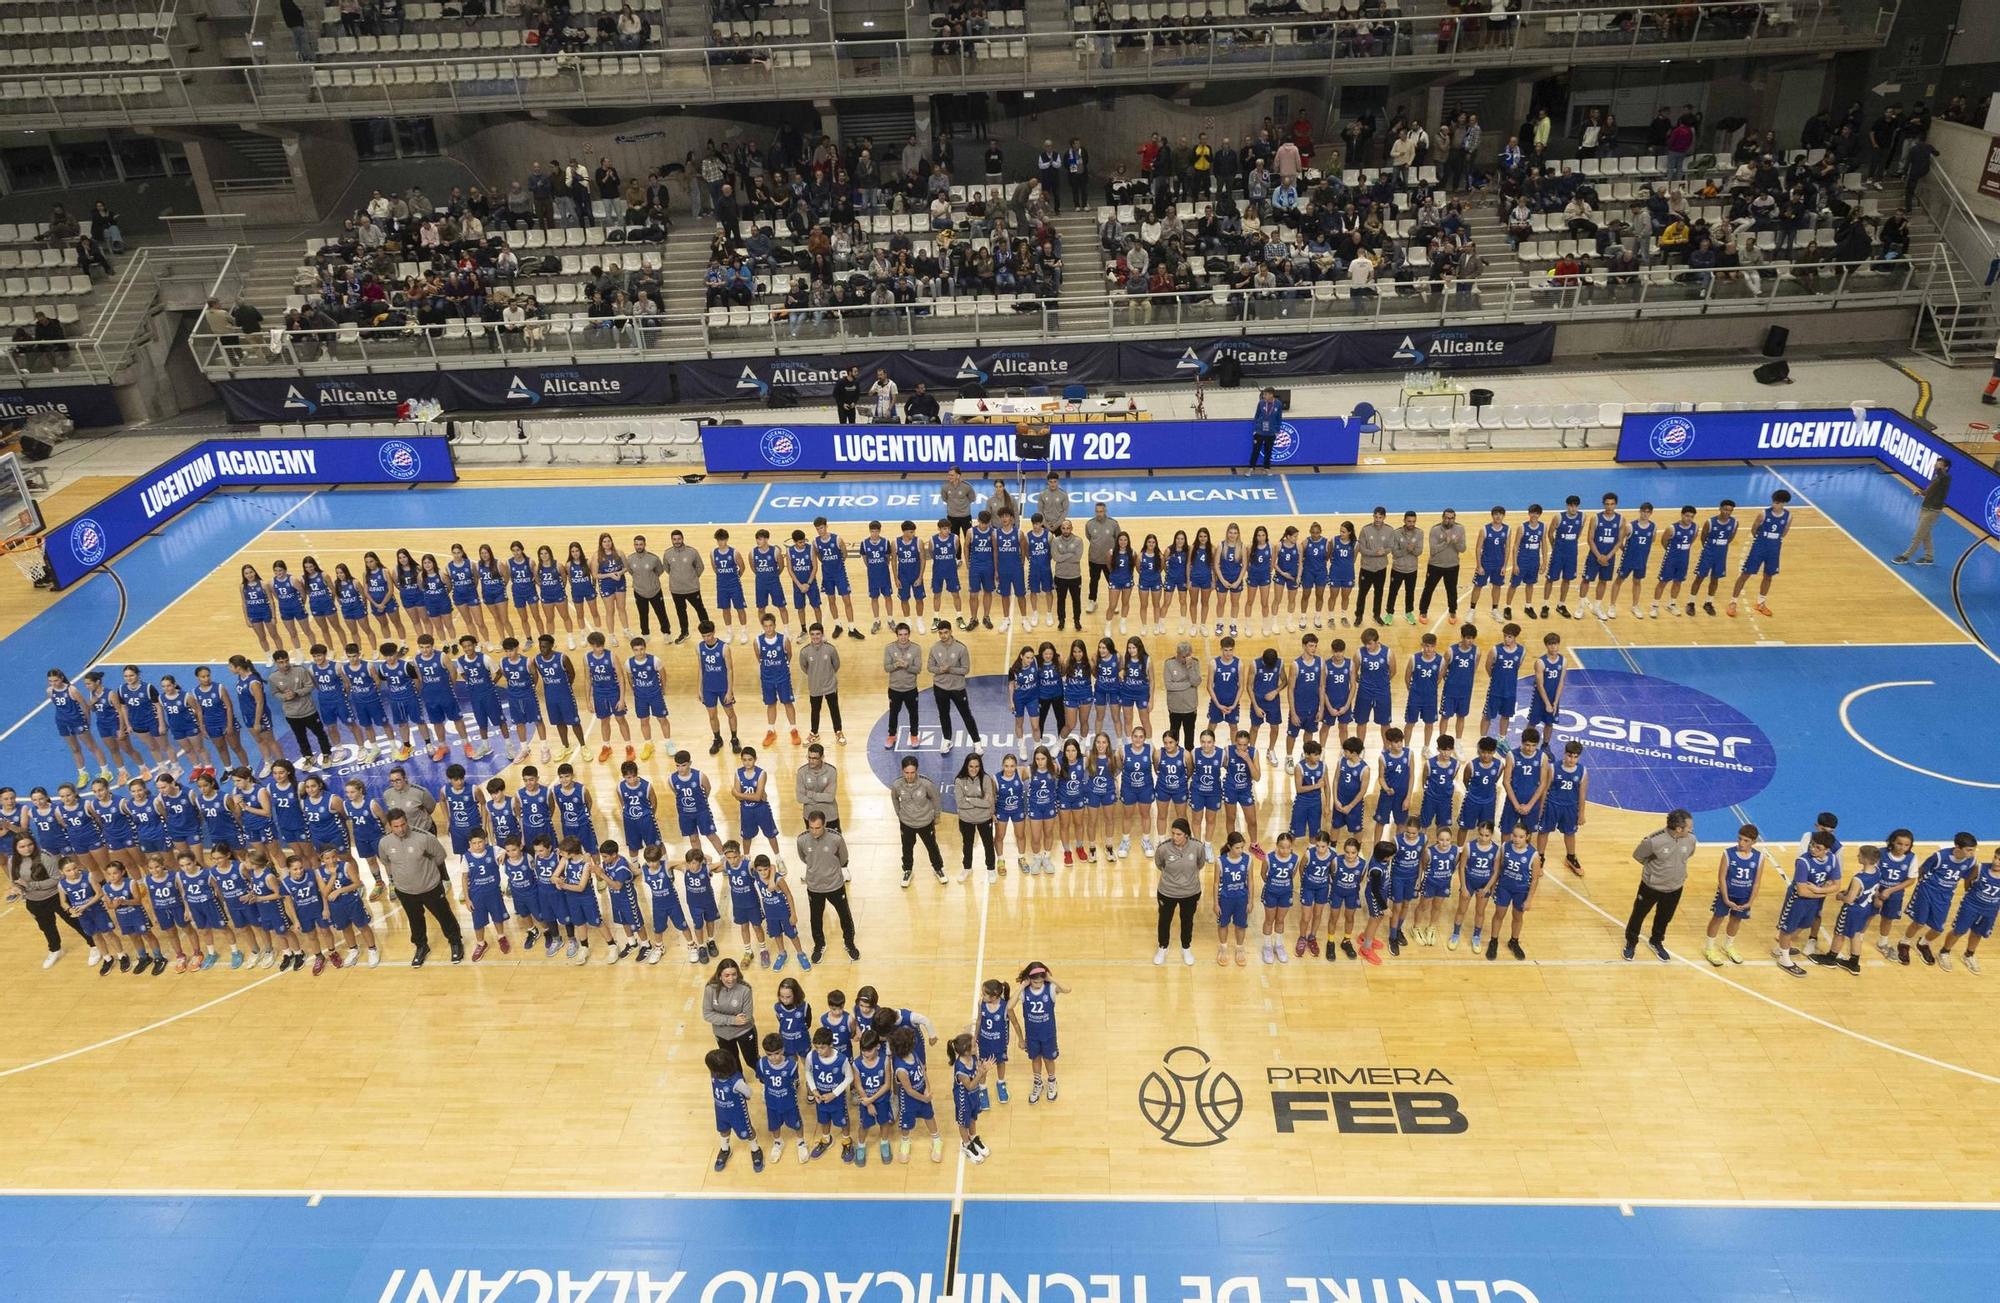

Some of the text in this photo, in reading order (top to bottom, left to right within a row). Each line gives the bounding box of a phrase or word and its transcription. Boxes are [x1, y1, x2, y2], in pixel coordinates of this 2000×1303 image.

[1430, 339, 1504, 353] Alicante
[993, 359, 1068, 373] Alicante
[544, 378, 620, 393] Alicante
[320, 389, 397, 403] Alicante
[765, 430, 794, 441] LUCENTUM
[833, 434, 955, 463] LUCENTUM
[1083, 432, 1131, 460] 202
[1757, 421, 1941, 481] LUCENTUM ACADEM
[140, 449, 317, 519] LUCENTUM ACADEMY
[770, 494, 879, 508] CENTRO
[887, 494, 921, 507] DE
[1147, 488, 1279, 502] ALICANTE
[1568, 525, 1573, 533] 7
[1604, 528, 1612, 536] 11
[1771, 524, 1778, 533] 9
[1527, 533, 1539, 543] 43
[1683, 535, 1688, 543] 2
[1718, 531, 1725, 539] 5
[978, 539, 989, 548] 27
[1002, 538, 1013, 548] 25
[1494, 537, 1499, 545] 6
[1638, 536, 1647, 545] 12
[940, 545, 950, 554] 18
[1035, 541, 1045, 551] 20
[823, 548, 832, 557] 21
[872, 549, 881, 558] 16
[903, 549, 913, 559] 19
[1229, 553, 1235, 561] 5
[1285, 553, 1291, 561] 8
[1313, 548, 1319, 556] 9
[1339, 549, 1348, 557] 10
[757, 558, 769, 568] 22
[795, 558, 805, 567] 24
[1119, 559, 1125, 567] 2
[1200, 554, 1205, 562] 4
[1258, 555, 1263, 563] 6
[719, 560, 728, 568] 17
[1148, 562, 1153, 570] 3
[455, 571, 465, 580] 19
[516, 570, 526, 579] 21
[248, 591, 258, 599] 15
[766, 649, 779, 658] 49
[704, 654, 717, 664] 48
[1457, 658, 1469, 668] 36
[593, 665, 606, 674] 42
[1368, 660, 1380, 671] 39
[1503, 660, 1514, 669] 32
[424, 665, 436, 675] 51
[467, 668, 479, 677] 35
[508, 670, 520, 679] 29
[542, 667, 556, 676] 50
[1044, 669, 1054, 679] 31
[1100, 666, 1112, 676] 35
[1129, 668, 1139, 677] 36
[1421, 668, 1432, 678] 34
[1546, 669, 1558, 679] 30
[317, 674, 330, 683] 40
[390, 676, 400, 684] 31
[1220, 671, 1231, 681] 17
[1262, 671, 1274, 681] 37
[1303, 672, 1315, 682] 33
[1334, 674, 1345, 684] 38
[54, 696, 67, 706] 39
[128, 696, 140, 706] 45
[200, 697, 213, 707] 43
[166, 704, 180, 714] 38
[1134, 762, 1141, 771] 9
[1236, 763, 1246, 772] 12
[1677, 754, 1754, 773] eficiente
[1098, 766, 1105, 775] 7
[1166, 764, 1177, 774] 10
[1203, 765, 1212, 774] 11
[1395, 764, 1402, 774] 4
[1522, 765, 1532, 775] 12
[1070, 771, 1077, 781] 6
[1345, 773, 1351, 783] 3
[1439, 774, 1446, 784] 5
[1482, 775, 1489, 785] 6
[1040, 779, 1047, 789] 2
[1561, 780, 1573, 790] 28
[681, 787, 693, 797] 10
[277, 797, 291, 808] 22
[628, 794, 642, 805] 22
[169, 803, 184, 814] 19
[452, 801, 465, 810] 23
[531, 803, 538, 813] 8
[563, 801, 575, 812] 18
[68, 816, 82, 826] 16
[99, 813, 112, 823] 17
[136, 812, 149, 822] 18
[307, 811, 321, 822] 23
[352, 815, 367, 826] 24
[495, 815, 507, 825] 14
[36, 820, 51, 831] 13
[1404, 850, 1418, 861] 30
[1438, 859, 1450, 870] 31
[1475, 857, 1489, 868] 32
[1507, 859, 1522, 872] 35
[478, 865, 486, 875] 3
[540, 866, 553, 877] 25
[1276, 867, 1289, 878] 25
[1313, 866, 1327, 877] 27
[1736, 867, 1750, 879] 31
[1887, 869, 1901, 880] 15
[1945, 869, 1961, 881] 34
[511, 871, 524, 881] 23
[731, 875, 743, 886] 46
[1230, 871, 1241, 881] 16
[1341, 872, 1356, 882] 28
[222, 879, 235, 890] 43
[650, 878, 663, 891] 37
[689, 876, 702, 887] 38
[155, 887, 172, 899] 40
[187, 884, 202, 894] 42
[296, 886, 311, 899] 47
[72, 888, 87, 901] 37
[1030, 1000, 1045, 1013] 22
[786, 1018, 793, 1030] 7
[986, 1019, 993, 1029] 9
[817, 1071, 833, 1084] 46
[1267, 1066, 1454, 1086] PRIMERA
[770, 1076, 782, 1087] 18
[864, 1075, 881, 1089] 45
[1271, 1091, 1469, 1135] FEB
